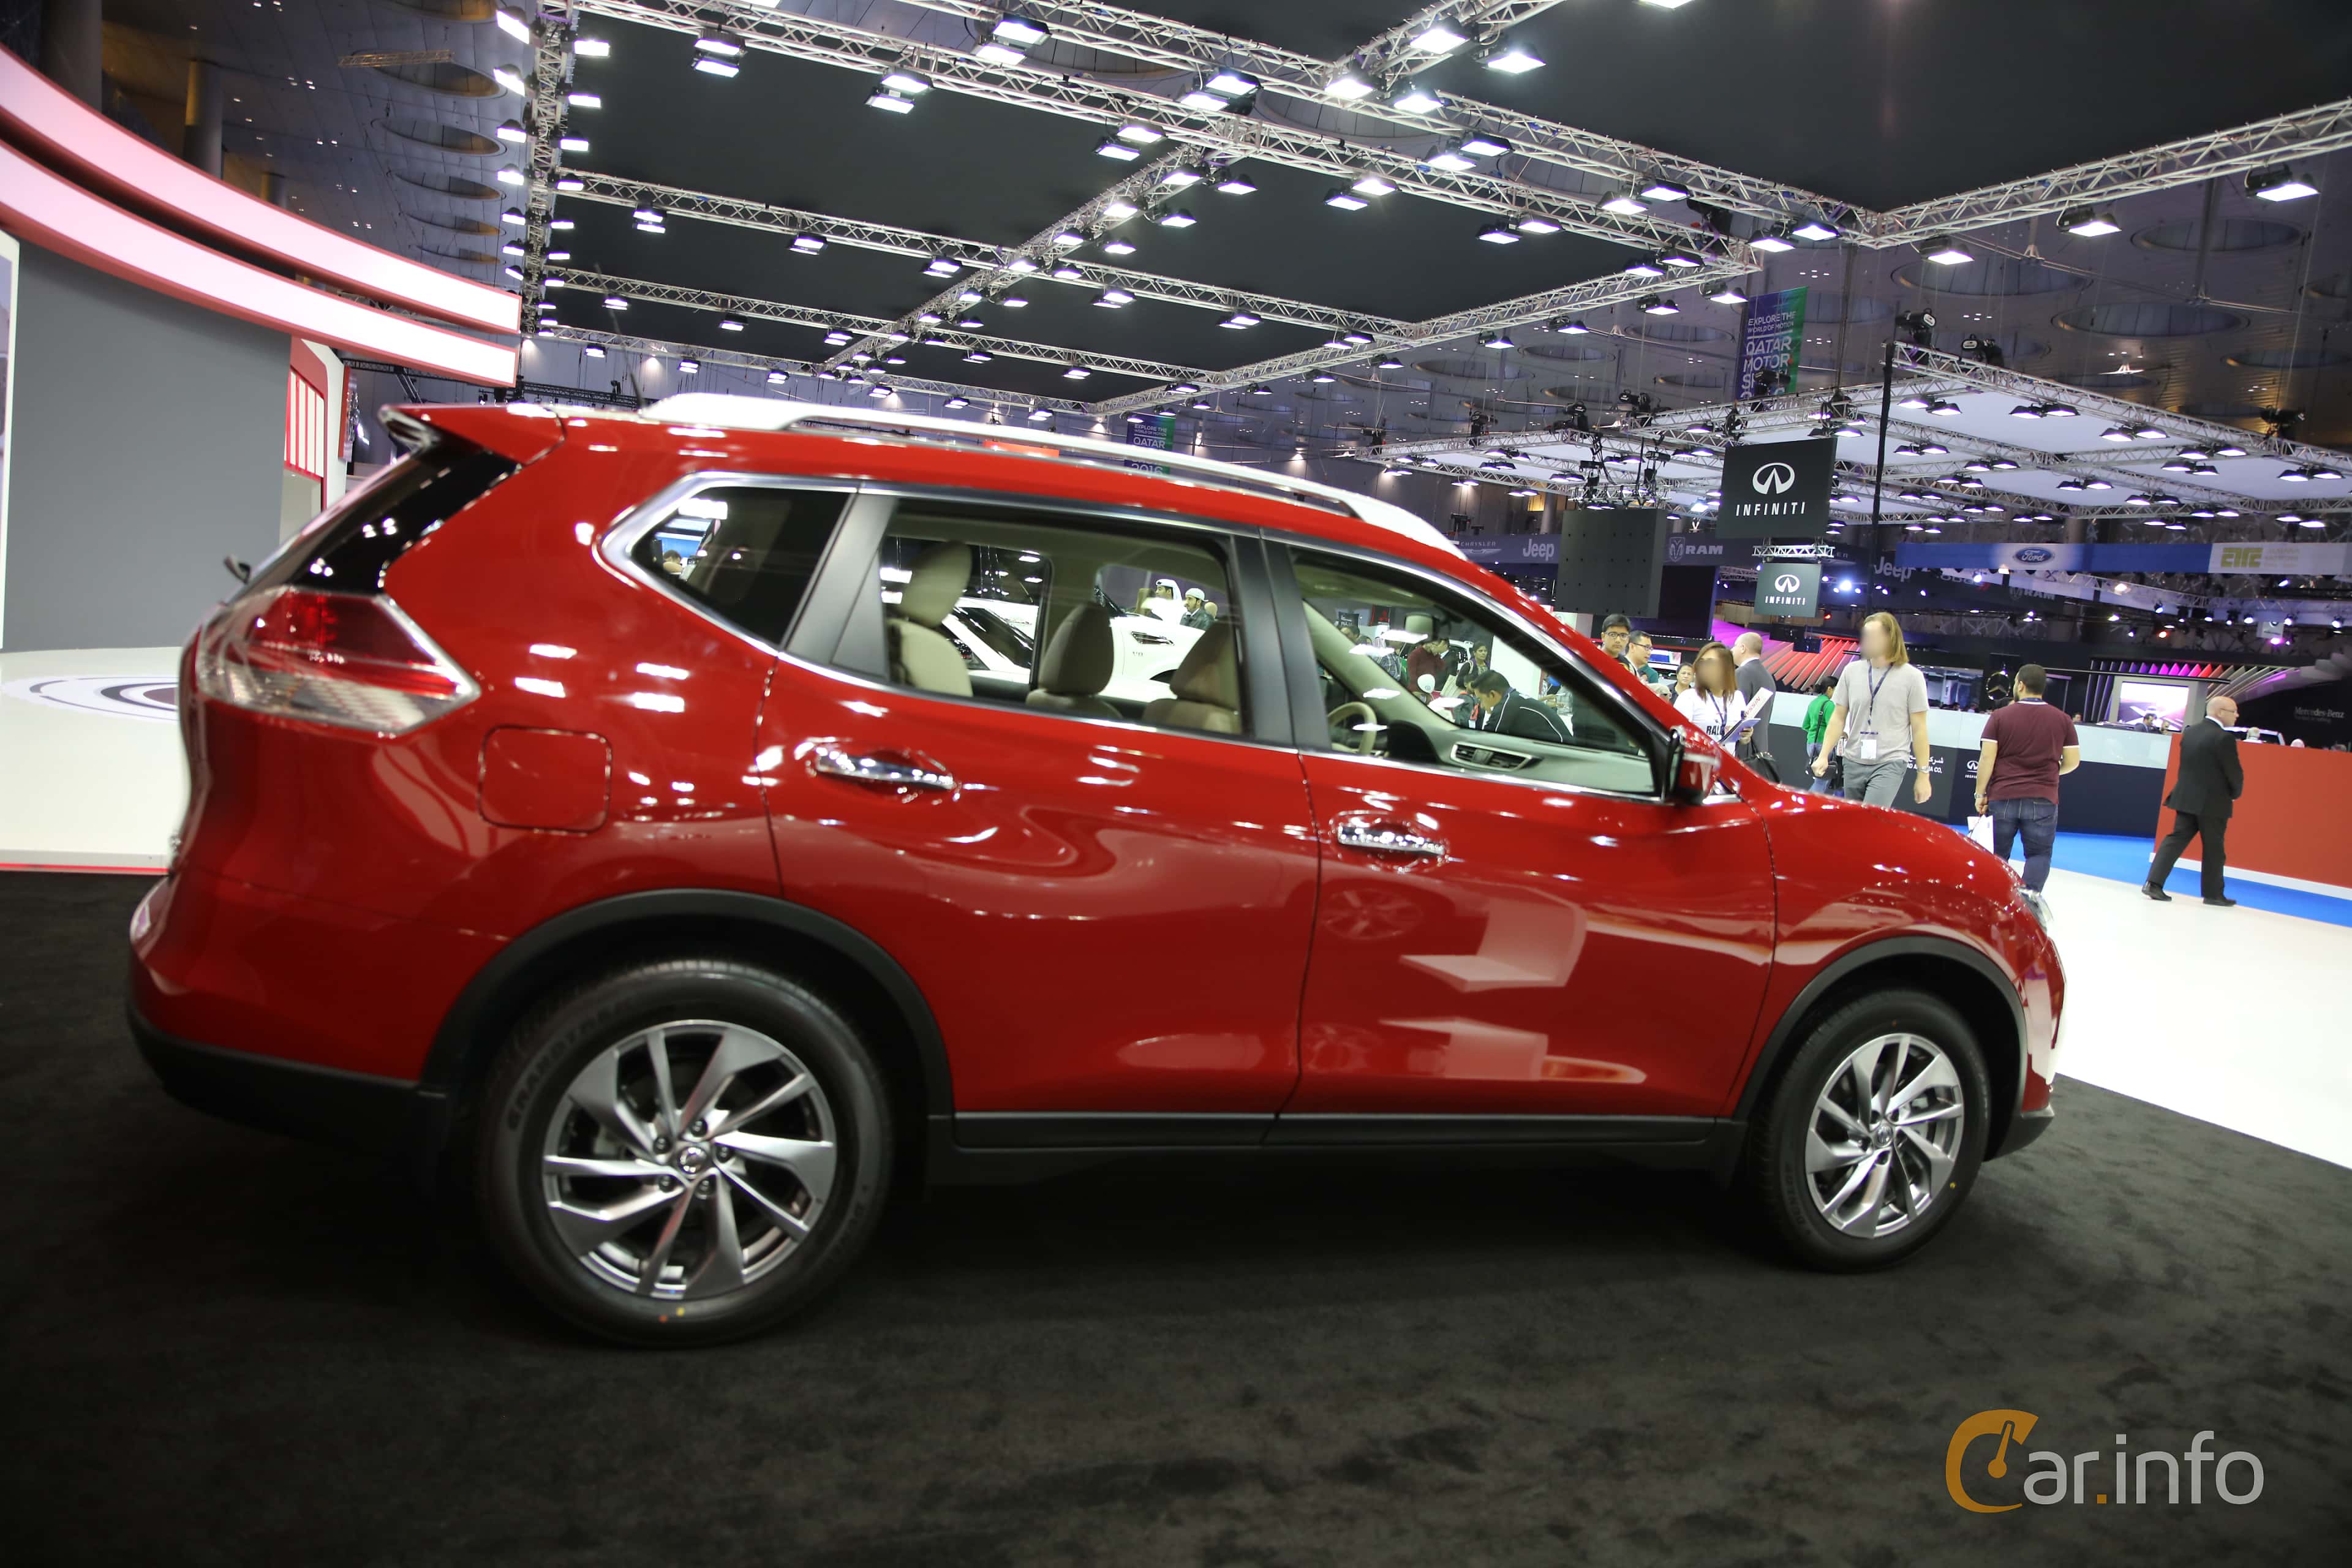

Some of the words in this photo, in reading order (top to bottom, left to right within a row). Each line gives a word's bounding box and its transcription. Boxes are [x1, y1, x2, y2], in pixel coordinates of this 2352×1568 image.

[1748, 314, 1781, 326] EXPLORE
[1781, 311, 1796, 321] THE
[1775, 321, 1794, 330] MOTION
[1746, 336, 1792, 355] QATAR
[1743, 353, 1790, 373] MOTOR
[1133, 437, 1166, 448] QATAR
[1735, 501, 1806, 516] INFINITI
[1523, 538, 1555, 562] Jeep
[1685, 545, 1724, 554] RAM
[2021, 549, 2045, 562] Ford
[1874, 556, 1912, 582] Jeep
[1765, 595, 1806, 606] INFINITI
